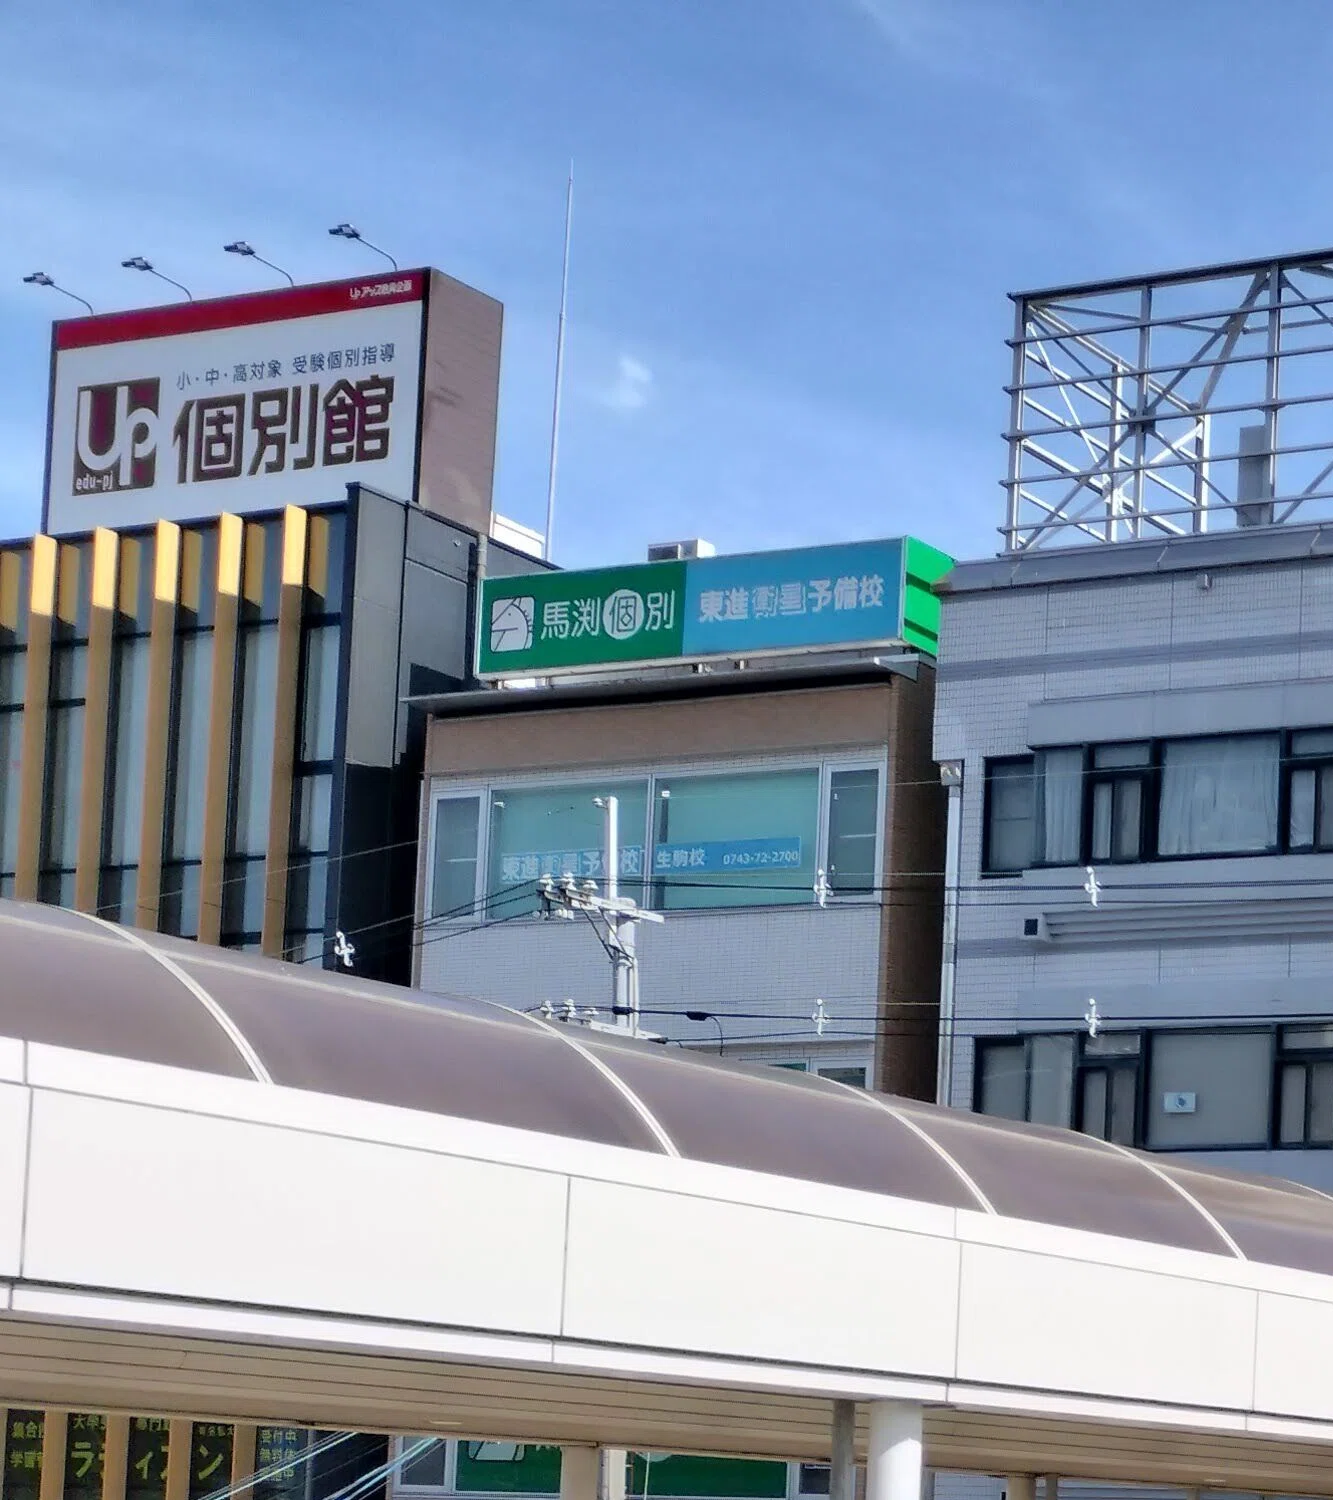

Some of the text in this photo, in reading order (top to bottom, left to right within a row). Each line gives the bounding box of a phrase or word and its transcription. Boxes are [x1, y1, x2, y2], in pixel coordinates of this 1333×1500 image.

[292, 342, 395, 374] 受験個別指導
[172, 374, 396, 484] 個別館
[699, 574, 885, 623] 東進衛星予備校
[502, 848, 639, 881] 東進衛星予校
[655, 848, 799, 868] 生駒校 0743-72-2700
